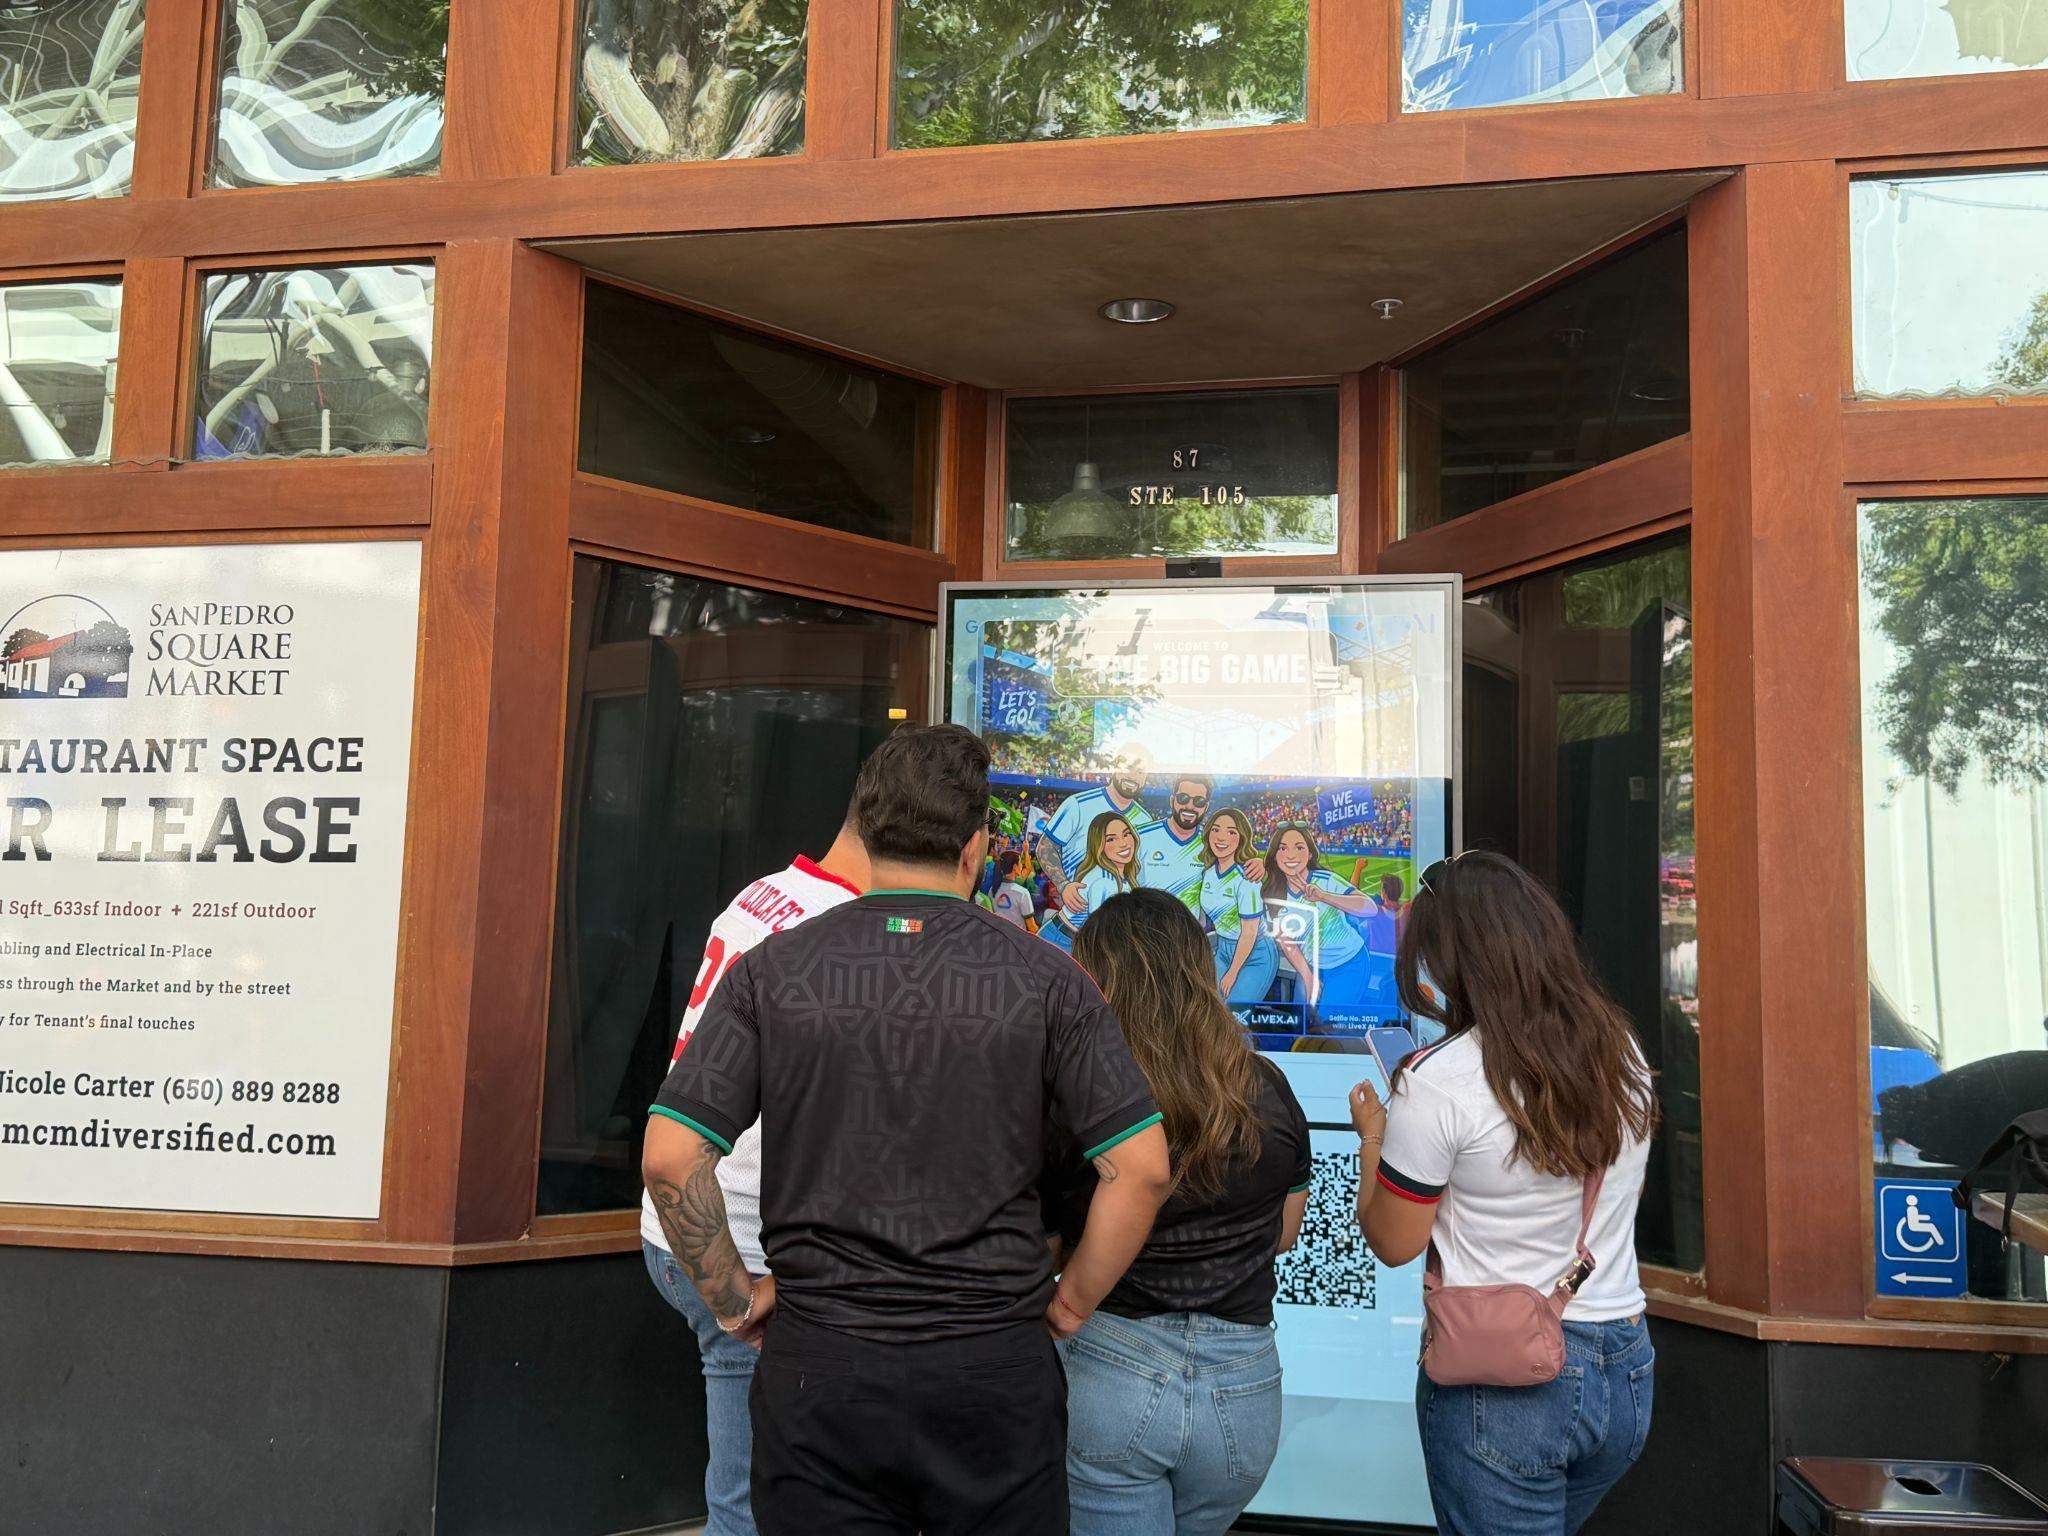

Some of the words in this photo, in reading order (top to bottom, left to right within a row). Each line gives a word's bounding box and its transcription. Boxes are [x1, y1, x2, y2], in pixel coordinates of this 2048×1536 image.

[1173, 450, 1198, 468] 87
[1130, 486, 1174, 505] STE
[1201, 486, 1244, 505] 105
[148, 630, 291, 667] SQUARE
[1153, 641, 1209, 651] WELCOME
[1215, 641, 1229, 651] TO
[1160, 654, 1211, 684] BIG
[1221, 654, 1307, 684] GAME
[145, 666, 289, 696] MARKET
[999, 690, 1037, 710] LET'S
[1005, 707, 1034, 727] GO!
[0, 738, 207, 773] TAURANT
[222, 737, 364, 773] SPACE
[1332, 789, 1353, 808] WE
[1325, 801, 1369, 826] BELIEVE
[2, 798, 52, 861] R
[97, 797, 360, 863] LEASE
[104, 901, 162, 916] Indoor
[171, 905, 181, 916] +
[192, 902, 238, 917] 221sf
[244, 903, 316, 918] Outdoor
[45, 943, 70, 955] and
[76, 943, 145, 956] Electrical
[150, 944, 212, 957] In-Place
[18, 977, 74, 993] through
[80, 978, 101, 991] the
[107, 979, 159, 992] Market
[164, 980, 191, 993] and
[196, 980, 214, 996] by
[219, 981, 242, 994] the
[248, 983, 291, 994] street
[9, 1013, 30, 1026] for
[34, 1014, 95, 1027] Tenant's
[100, 1015, 133, 1028] final
[138, 1017, 194, 1030] touches
[1251, 1014, 1299, 1025] LIVEX.AI
[1329, 1014, 1348, 1022] Selfie
[74, 1073, 154, 1097] Carter
[163, 1077, 223, 1106] (650)
[232, 1081, 273, 1102] 889
[283, 1082, 340, 1104] 8288
[2, 1119, 336, 1155] mcmdiversified.com
